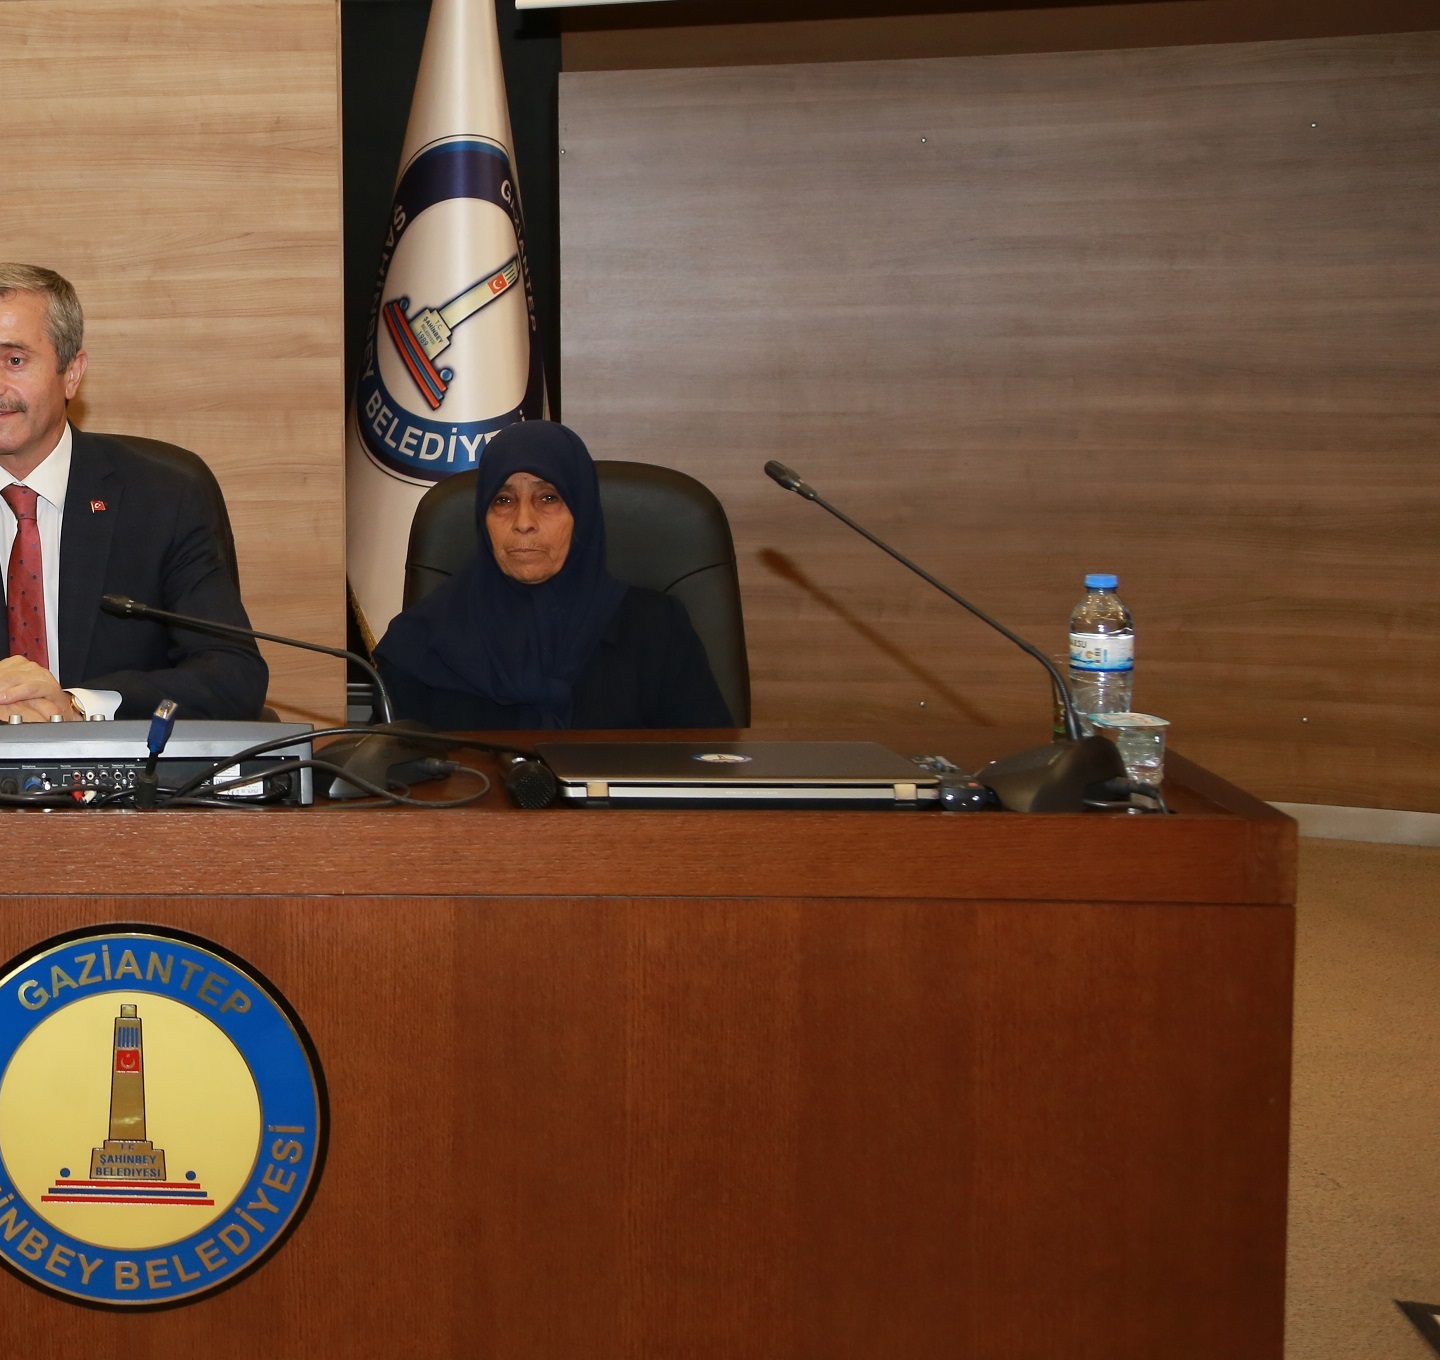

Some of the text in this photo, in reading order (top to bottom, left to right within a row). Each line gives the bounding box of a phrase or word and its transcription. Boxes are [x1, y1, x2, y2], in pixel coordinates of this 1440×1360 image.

[365, 389, 526, 463] BELEDİY
[17, 944, 252, 1016] GAZİANTEP
[100, 1153, 156, 1166] ŞAHİNBEY
[114, 1125, 305, 1291] BELEDİYESİ
